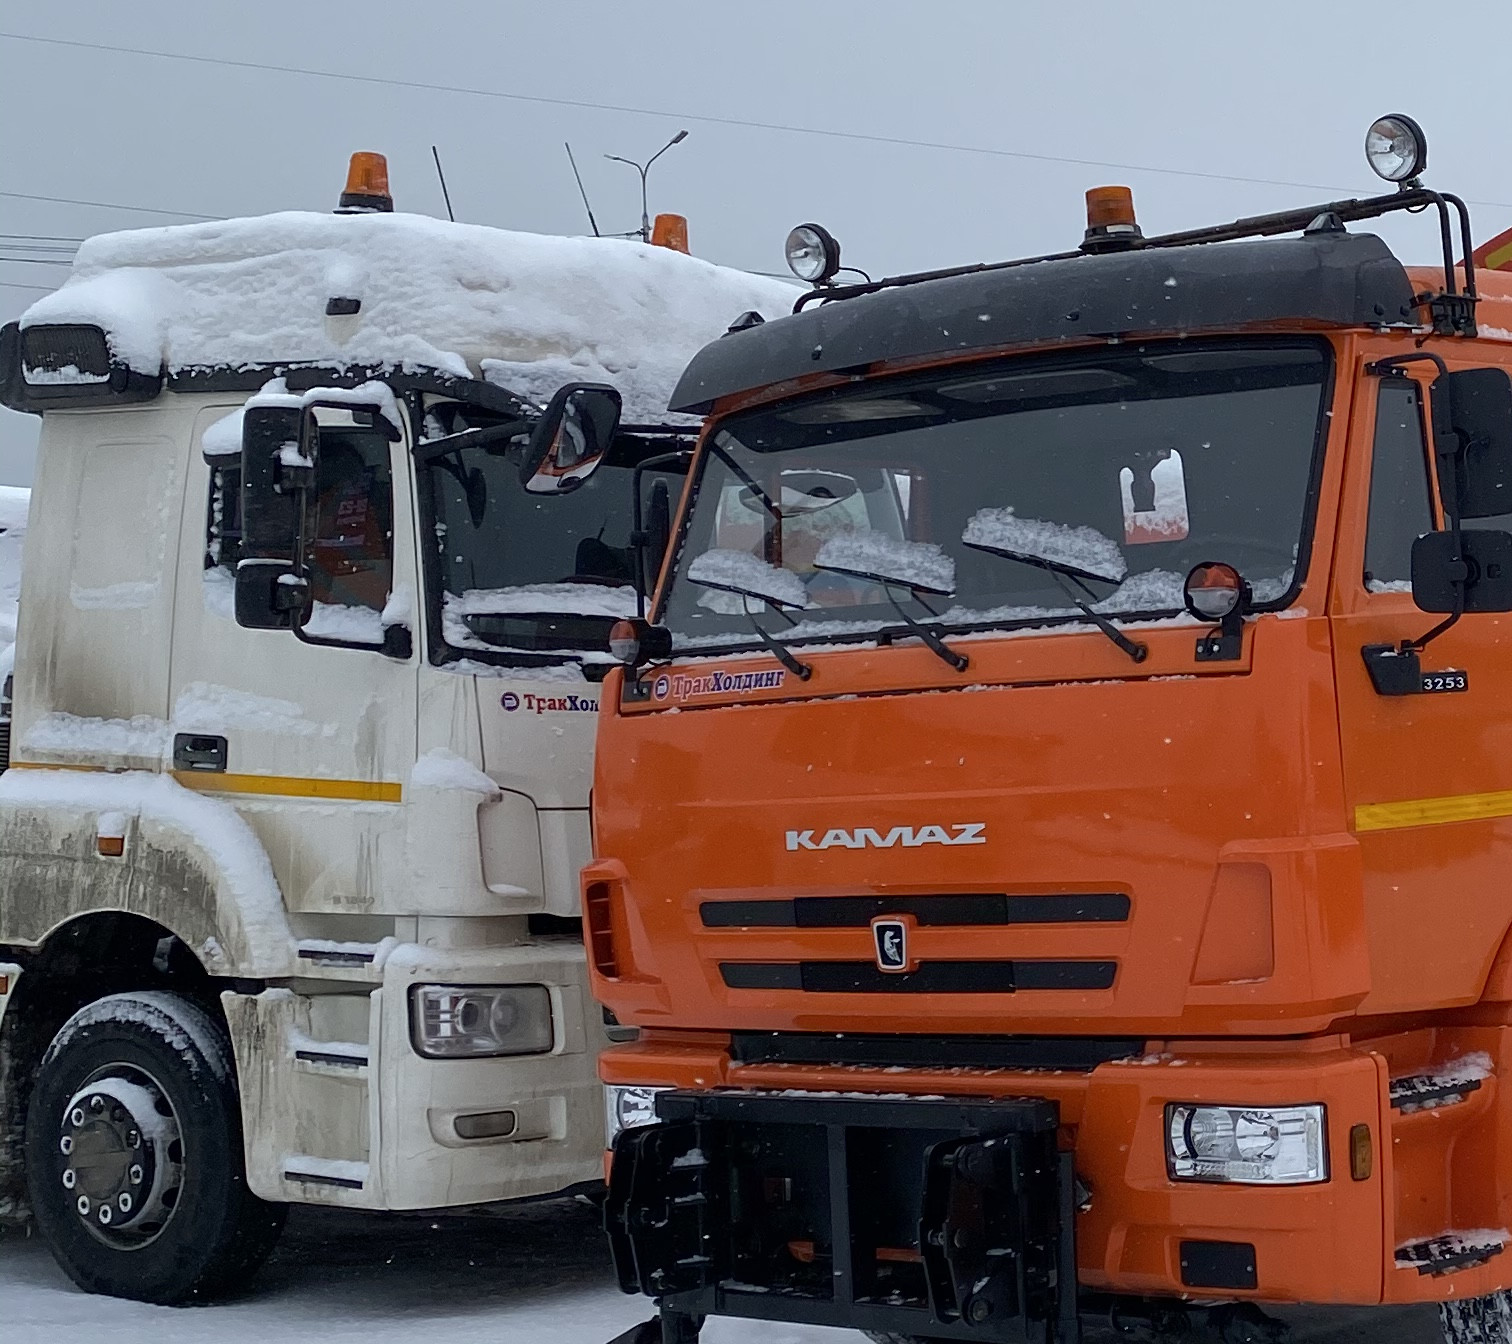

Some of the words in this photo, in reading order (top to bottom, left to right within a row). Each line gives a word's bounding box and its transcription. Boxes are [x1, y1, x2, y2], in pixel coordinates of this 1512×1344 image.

[673, 670, 784, 699] ТракХолдинг
[1423, 676, 1466, 690] 3253
[785, 822, 986, 851] KAMAZ
